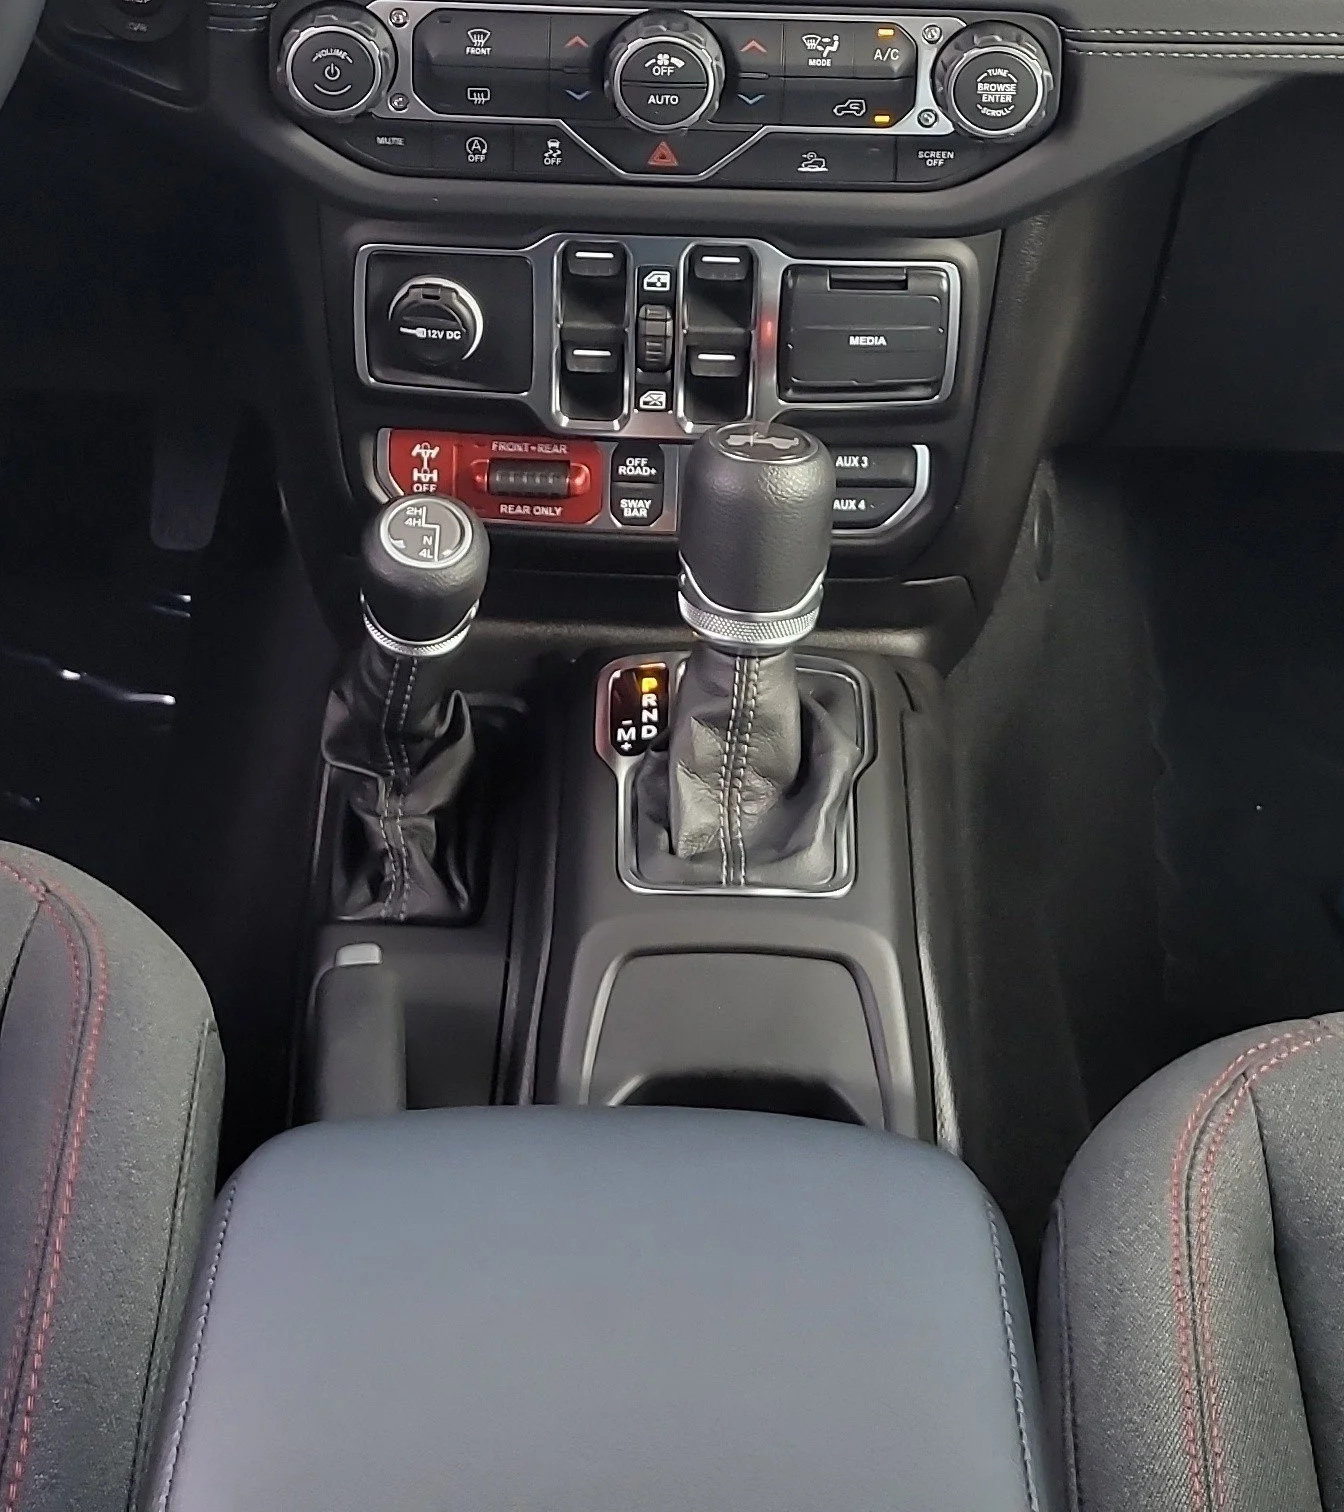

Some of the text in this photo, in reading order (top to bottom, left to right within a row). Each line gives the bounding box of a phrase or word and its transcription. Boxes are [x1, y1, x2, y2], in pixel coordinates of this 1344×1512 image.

[466, 47, 492, 55] FRONT
[874, 48, 899, 61] A/C
[809, 58, 832, 67] MODE
[653, 66, 674, 76] OFF
[987, 69, 1009, 78] TUNE
[977, 82, 1017, 93] BROWSE
[648, 95, 679, 105] AUTO
[981, 93, 1012, 103] ENTER
[980, 105, 1013, 117] SCROLL
[468, 154, 485, 163] OFF
[918, 150, 954, 160] SCREEN
[543, 156, 562, 166] OFF
[926, 158, 944, 167] OFF
[428, 329, 461, 339] 12V DC
[849, 335, 887, 346] MEDIA
[626, 458, 648, 467] OFF
[836, 456, 868, 467] AUX 3
[413, 484, 437, 492] OFF
[620, 499, 652, 509] SWAY
[833, 499, 865, 510] AUX 4
[406, 507, 423, 515] 2H
[500, 504, 563, 516] REAR ONLY
[623, 508, 647, 517] BAR
[404, 518, 422, 526] 4H
[423, 536, 432, 545] N
[418, 549, 433, 559] 4L
[642, 678, 658, 692] P
[642, 693, 657, 707] R
[642, 708, 658, 723] N
[617, 727, 636, 742] M
[642, 725, 657, 739] D
